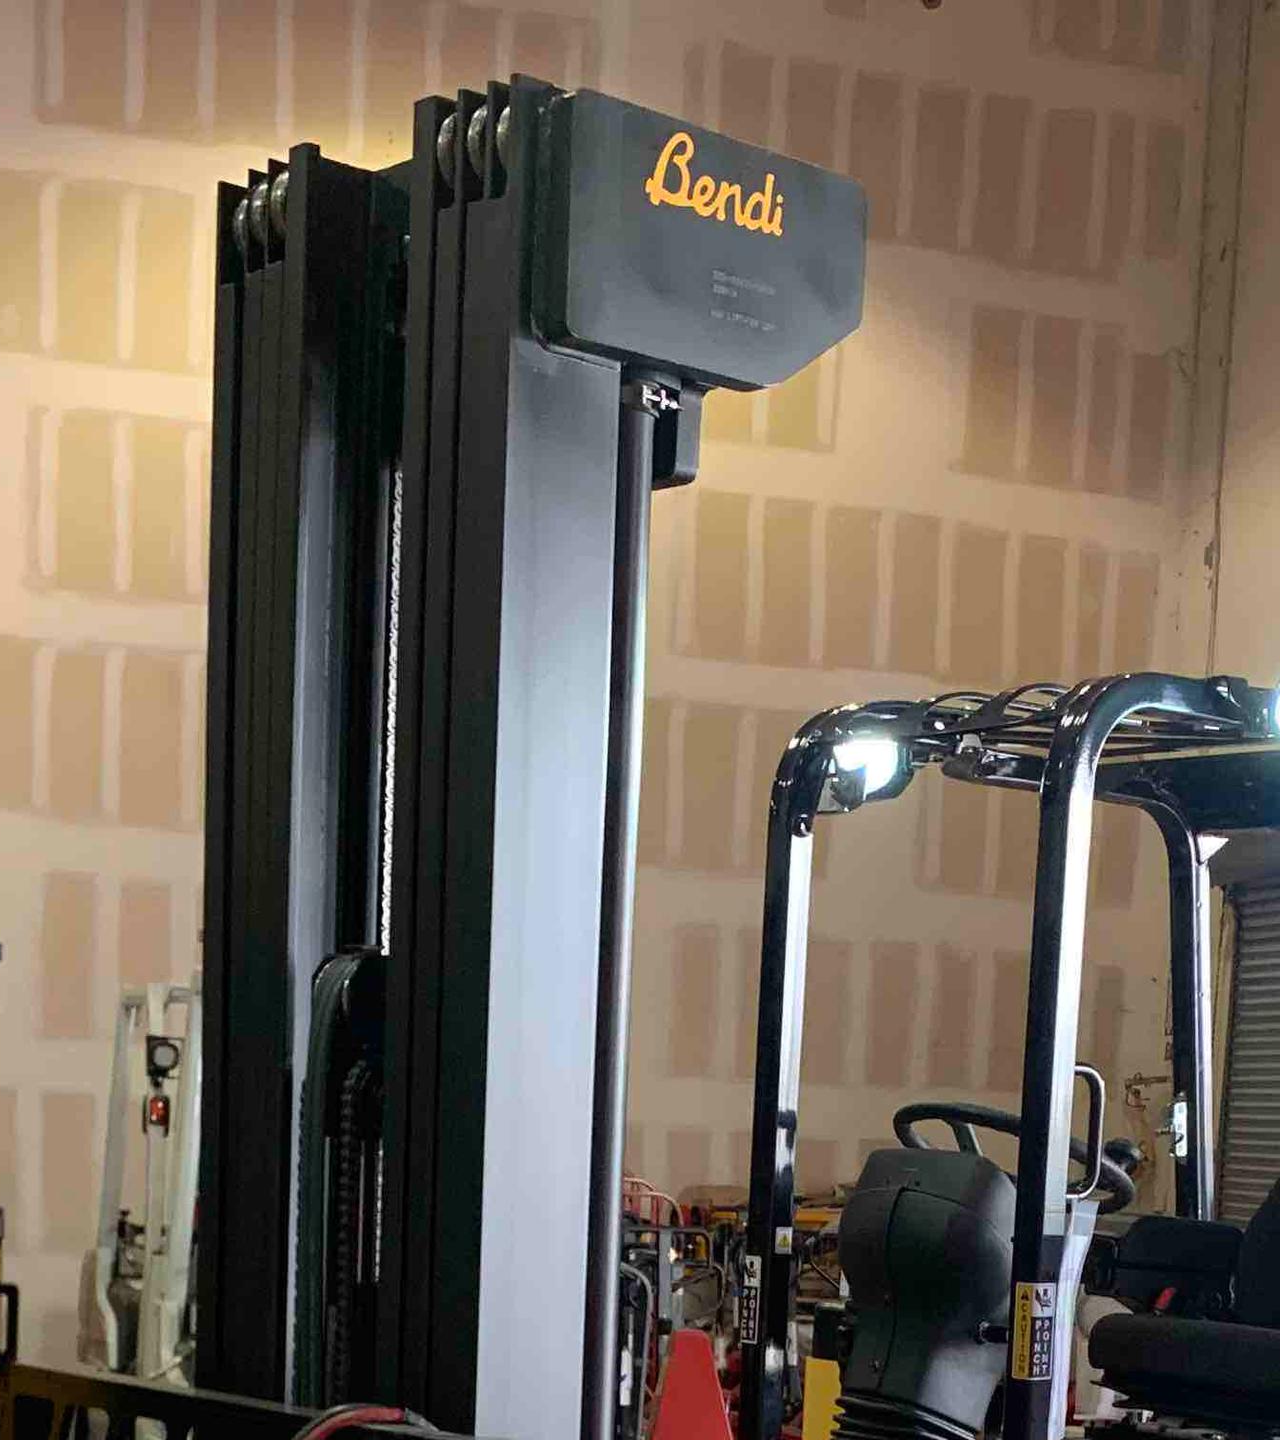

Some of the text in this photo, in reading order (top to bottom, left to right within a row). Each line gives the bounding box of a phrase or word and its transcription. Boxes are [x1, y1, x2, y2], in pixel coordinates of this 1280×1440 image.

[645, 132, 783, 236] Bendi
[1018, 1303, 1028, 1374] CAUTION
[1033, 1320, 1041, 1376] PINCH
[1041, 1320, 1050, 1375] POINT
